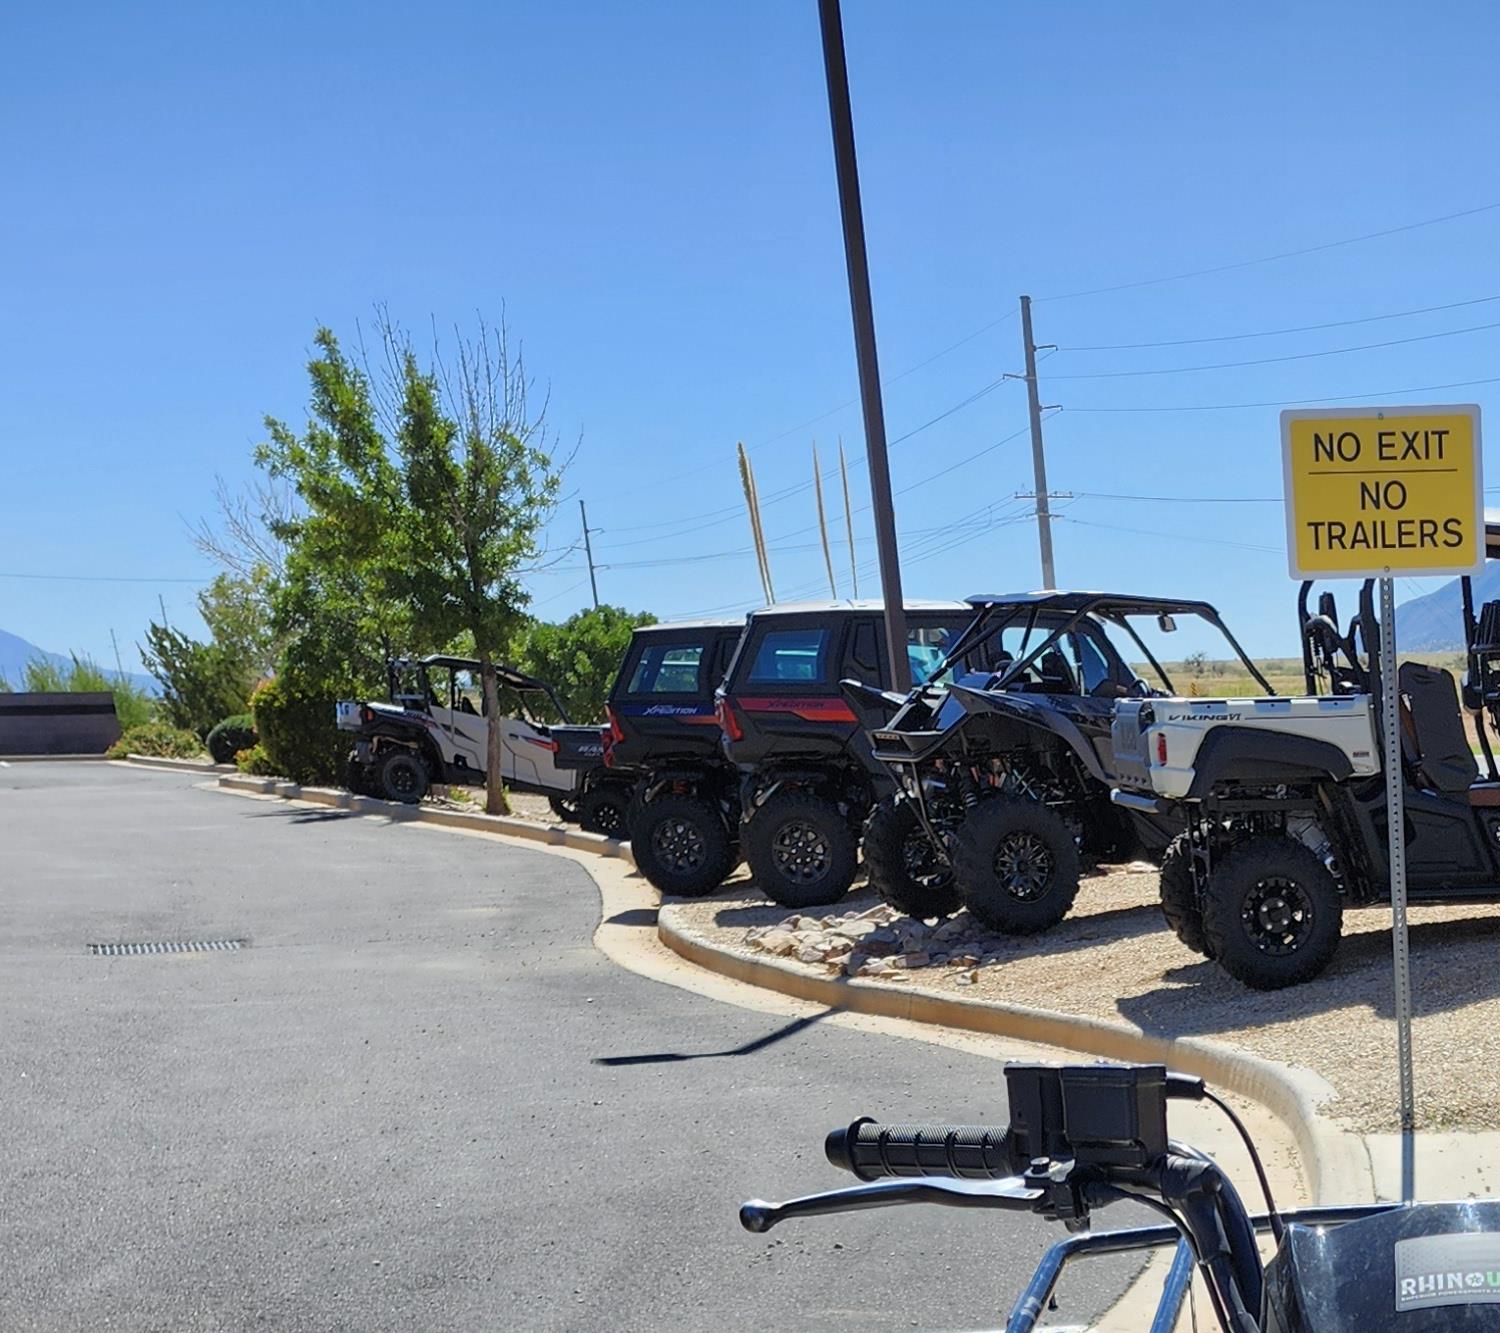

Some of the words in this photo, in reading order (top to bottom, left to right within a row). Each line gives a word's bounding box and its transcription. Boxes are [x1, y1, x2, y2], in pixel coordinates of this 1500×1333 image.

[1313, 432, 1361, 462] NO
[1378, 430, 1450, 461] EXIT
[1360, 480, 1407, 510] NO
[1307, 518, 1464, 550] TRAILERS
